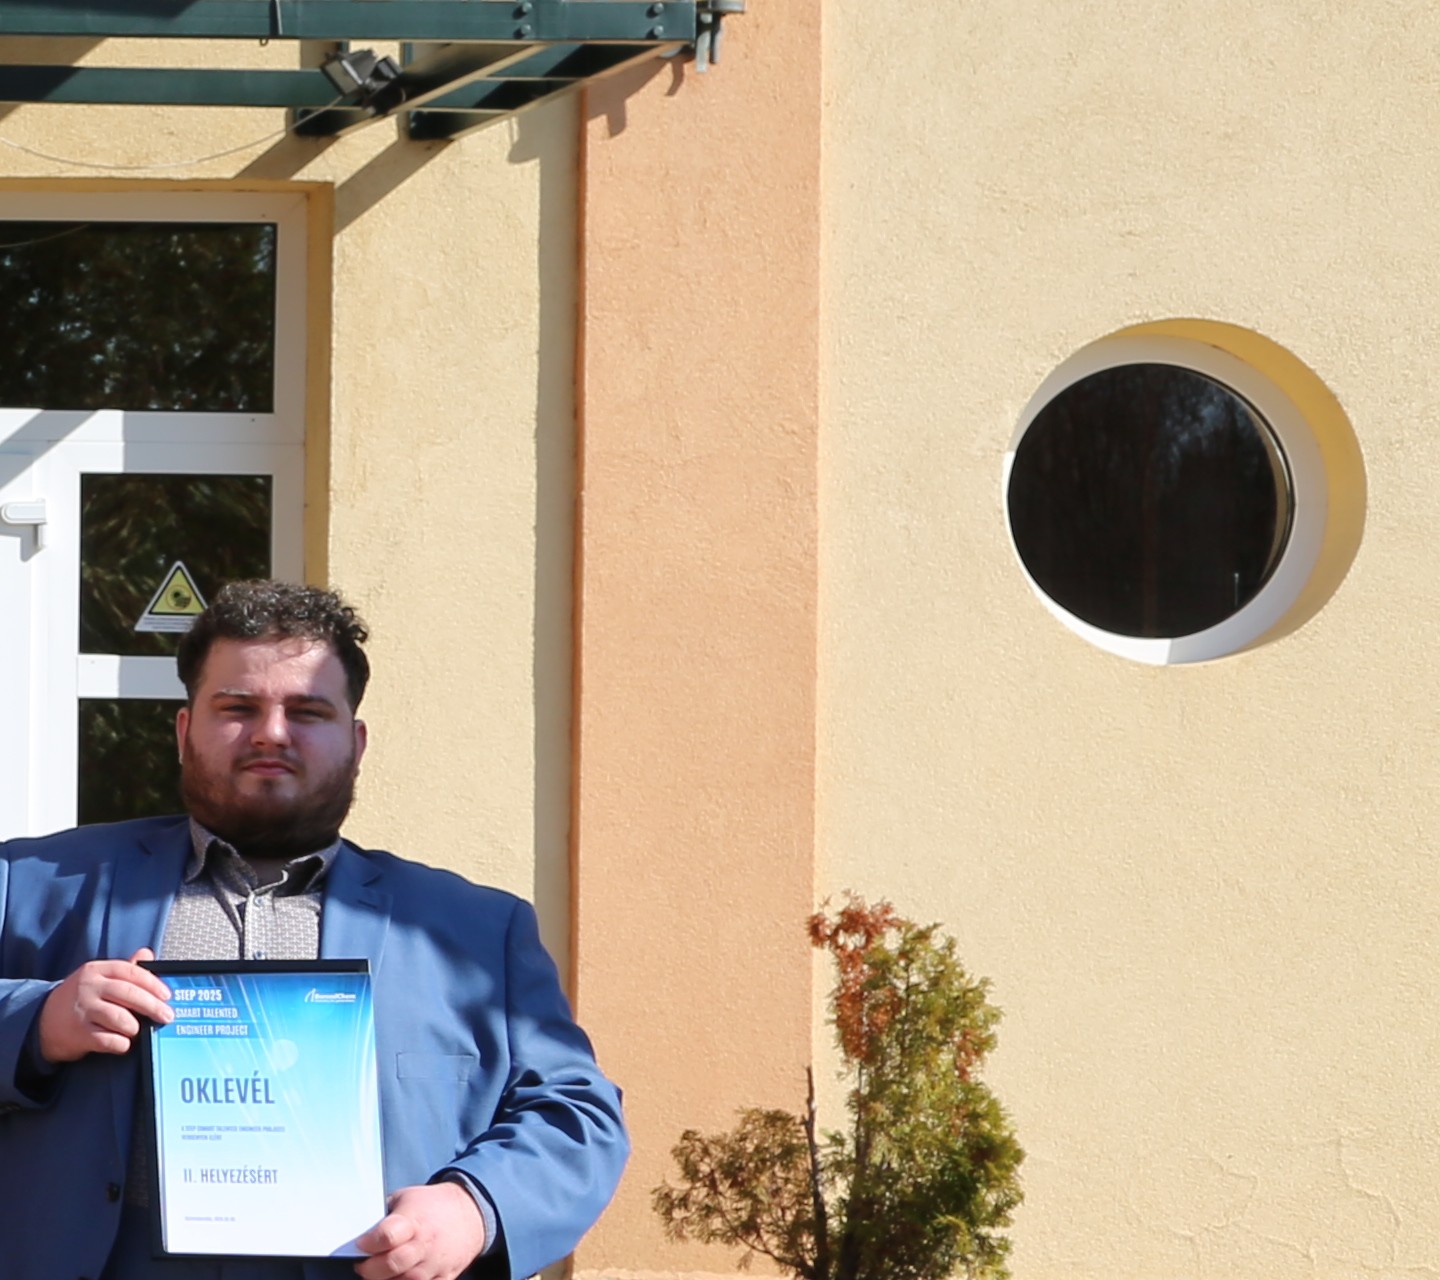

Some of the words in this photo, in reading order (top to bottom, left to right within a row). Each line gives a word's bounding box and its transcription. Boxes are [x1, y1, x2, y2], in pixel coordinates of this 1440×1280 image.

[175, 989, 196, 1001] STEP
[197, 989, 222, 1001] 2025
[175, 1007, 201, 1018] SMART
[203, 1007, 238, 1018] TALENTED
[176, 1024, 213, 1035] ENGINEER
[215, 1024, 248, 1035] PROJECT
[181, 1070, 275, 1104] OKLEVÉL
[183, 1168, 197, 1183] II.
[201, 1165, 278, 1184] HELYEZÉSÉRT
